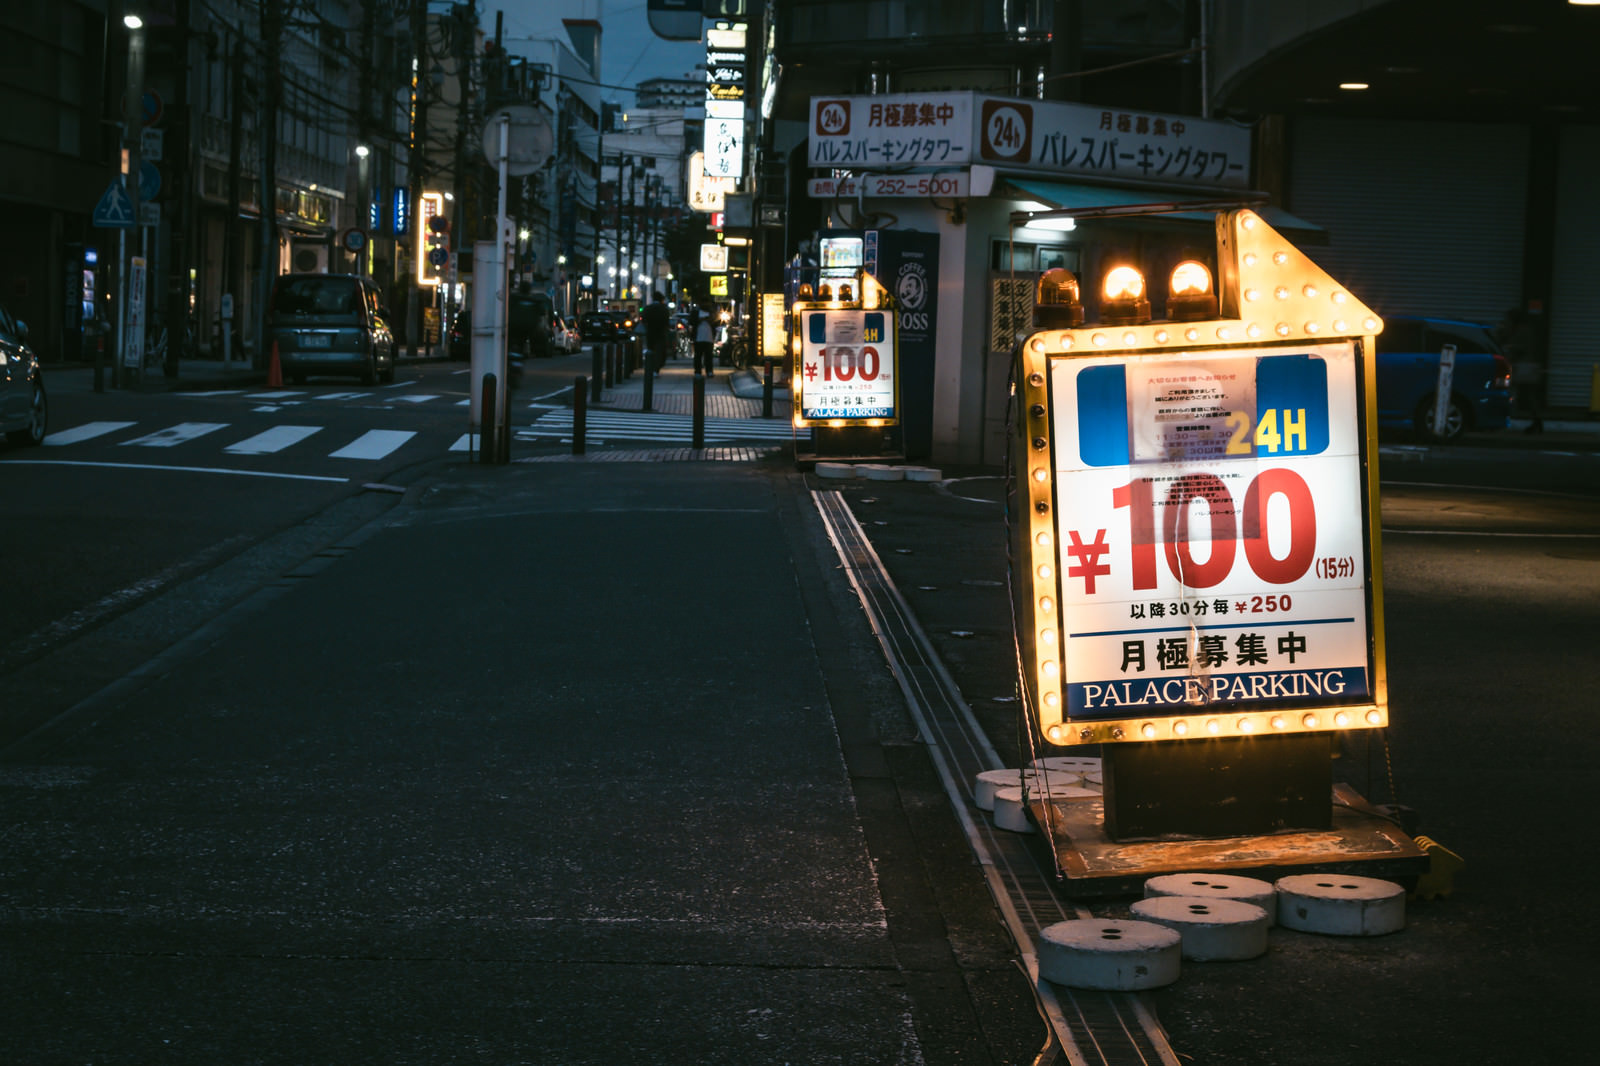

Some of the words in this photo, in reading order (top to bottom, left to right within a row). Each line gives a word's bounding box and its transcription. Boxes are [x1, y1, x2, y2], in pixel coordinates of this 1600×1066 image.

[824, 109, 842, 127] 24h
[869, 102, 954, 127] 月極募集中
[1099, 111, 1185, 138] 月極募集中
[994, 115, 1020, 149] 24h
[815, 136, 963, 162] パレスパーキングタワー
[1039, 132, 1244, 182] パレスパーキングタワー
[876, 178, 959, 195] 252-5001
[898, 262, 926, 277] COFFEE
[807, 408, 844, 417] PALACE
[846, 407, 888, 417] PARKING
[1225, 408, 1308, 456] 24H
[1068, 468, 1317, 594] ¥100
[1315, 556, 1355, 580] (15分)
[1130, 599, 1229, 620] 以降30分毎
[1234, 594, 1293, 614] ¥250
[1120, 631, 1307, 674] 月極募集中
[1083, 678, 1204, 709] PALACE
[1210, 670, 1347, 702] PARKING
